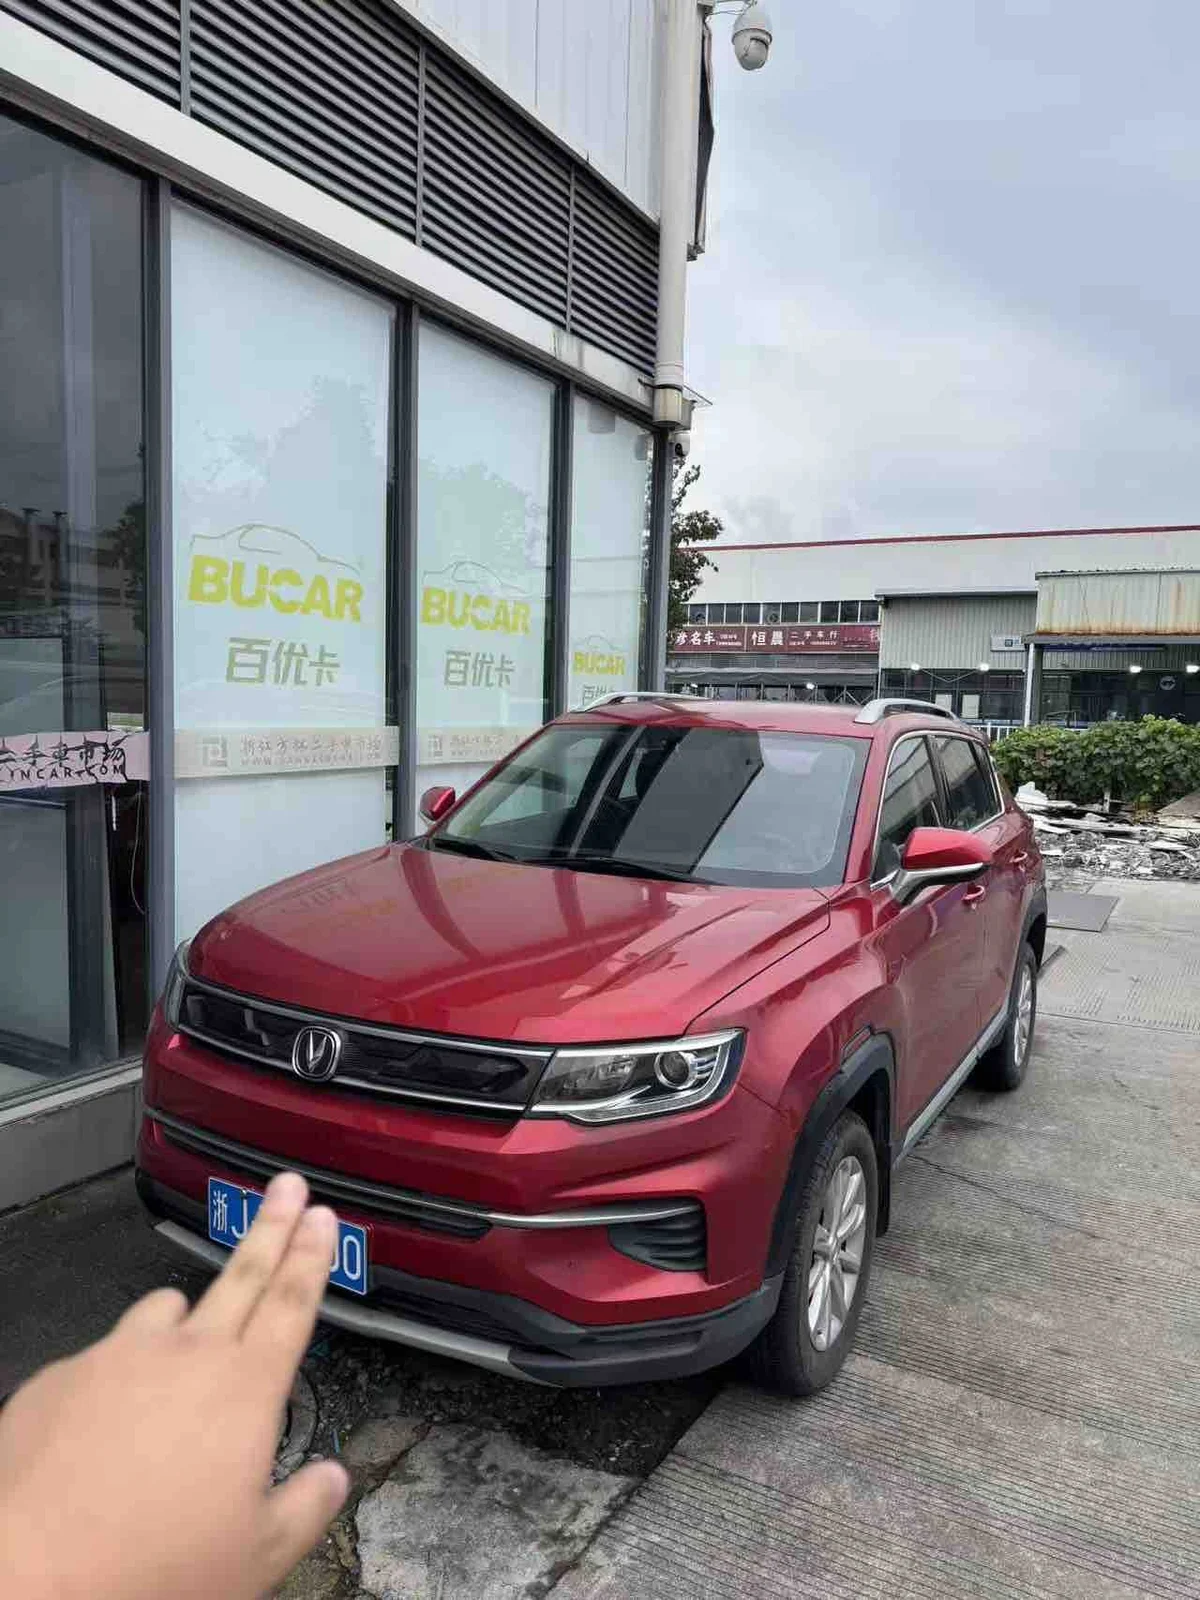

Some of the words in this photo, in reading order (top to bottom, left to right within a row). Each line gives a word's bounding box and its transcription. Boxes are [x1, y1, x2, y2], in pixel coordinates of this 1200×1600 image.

[188, 555, 364, 622] BUCAR
[421, 587, 531, 634] BUCAR
[225, 637, 341, 687] 百优卡
[443, 650, 516, 688] 百优卡
[573, 651, 626, 675] BUCAR
